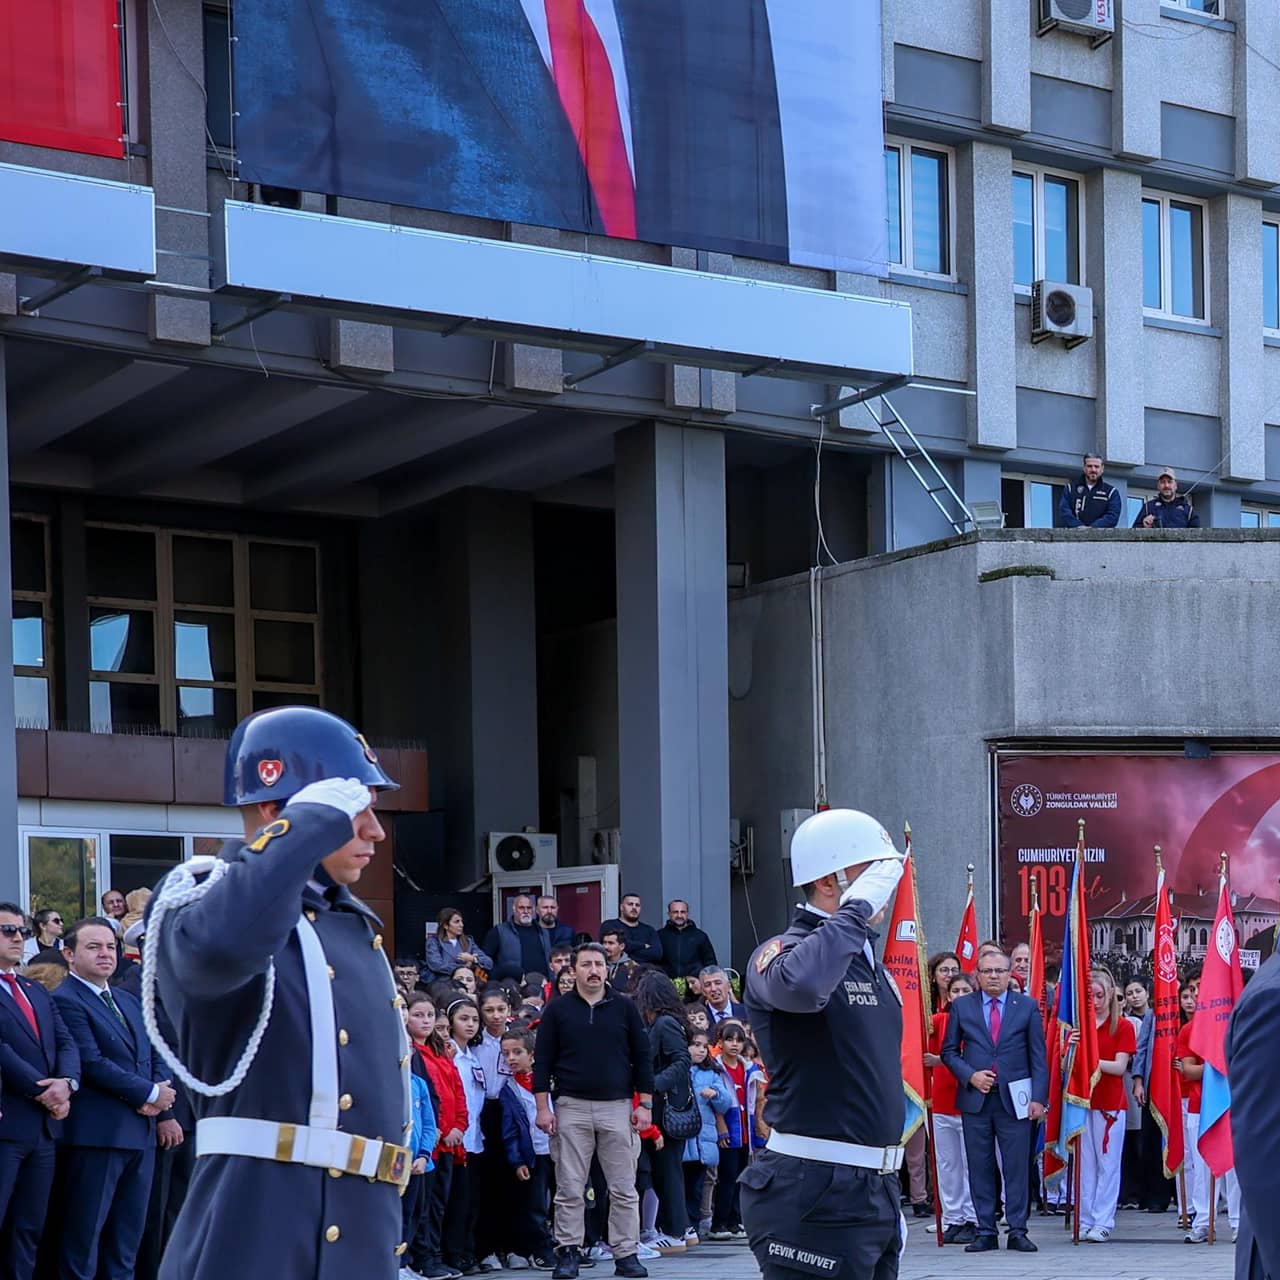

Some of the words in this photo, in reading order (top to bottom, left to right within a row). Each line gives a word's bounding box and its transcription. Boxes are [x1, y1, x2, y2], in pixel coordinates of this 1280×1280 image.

[1046, 792, 1072, 800] TÜRKİYE
[1073, 792, 1118, 800] CUMHURİYETİ
[1046, 801, 1088, 809] ZONGULDAK
[1089, 801, 1118, 809] VALİLİĞİ
[1018, 847, 1105, 862] CUMHURİYETİZİN
[1018, 865, 1066, 916] 103
[768, 1242, 795, 1260] ÇEVİK
[796, 1250, 837, 1270] KUVVET
